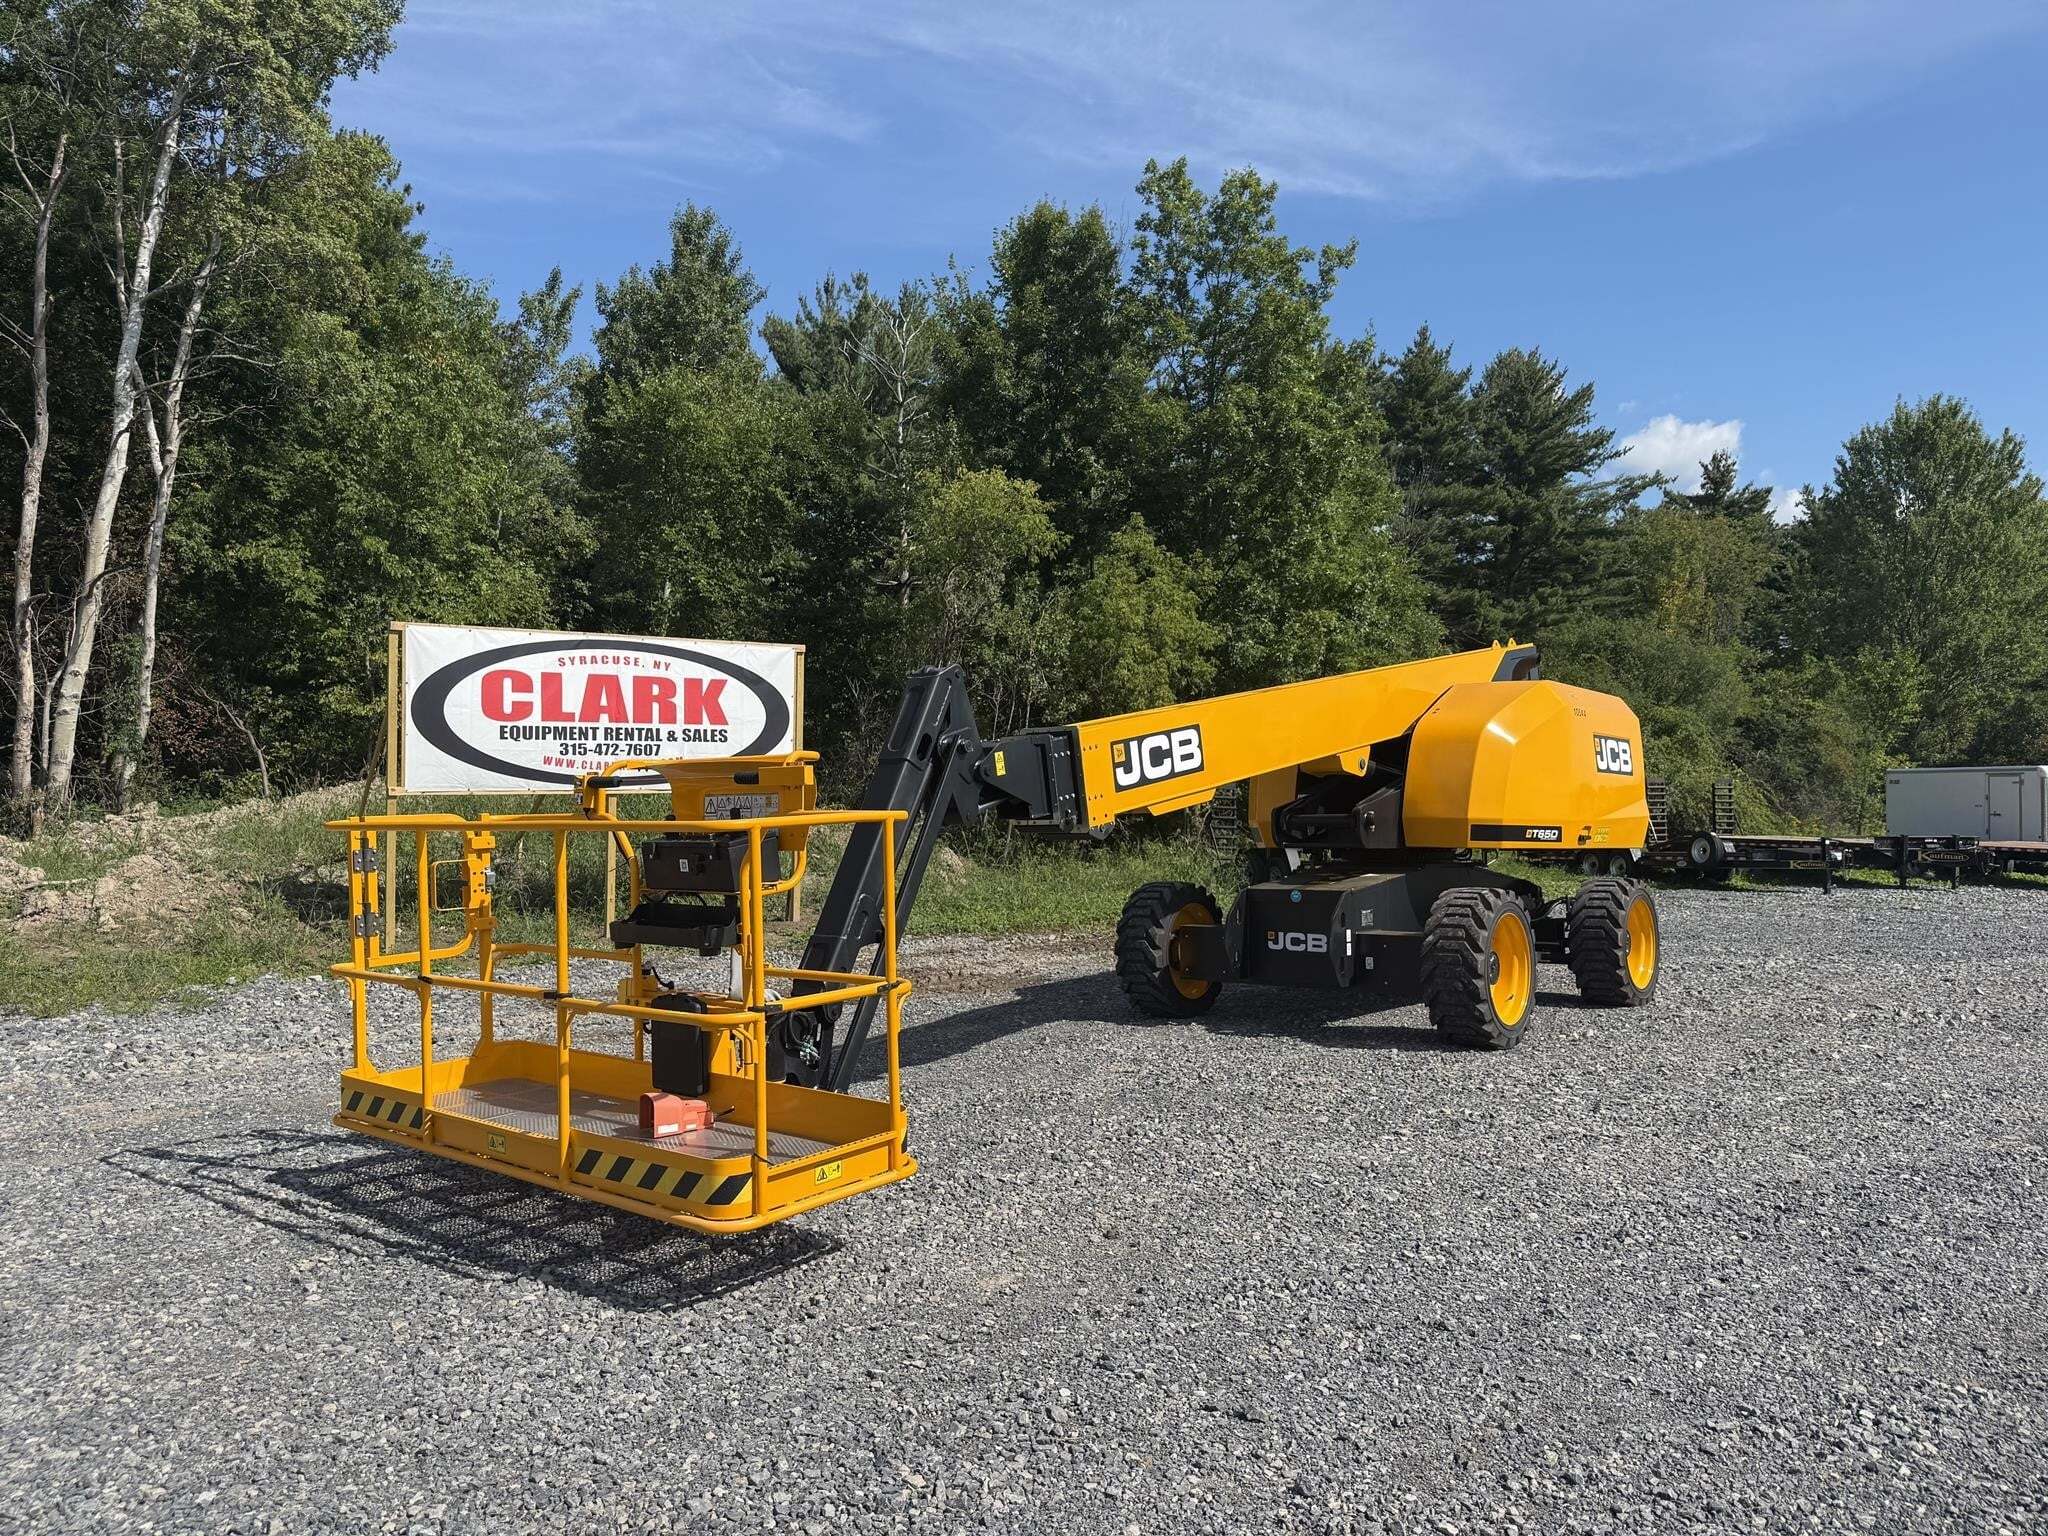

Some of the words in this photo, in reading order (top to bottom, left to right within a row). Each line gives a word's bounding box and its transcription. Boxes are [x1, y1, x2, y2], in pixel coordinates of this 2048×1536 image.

[653, 660, 672, 672] NY
[481, 669, 728, 725] CLARK
[499, 726, 599, 741] EQUIPMENT
[604, 727, 663, 742] RENTAL
[667, 729, 678, 742] &
[682, 728, 728, 743] SALES
[559, 742, 661, 757] 315-472-7607
[1115, 728, 1202, 786] JCB
[1596, 738, 1632, 772] JCB
[1918, 850, 1966, 862] Kaufman
[1268, 932, 1327, 952] JCB
